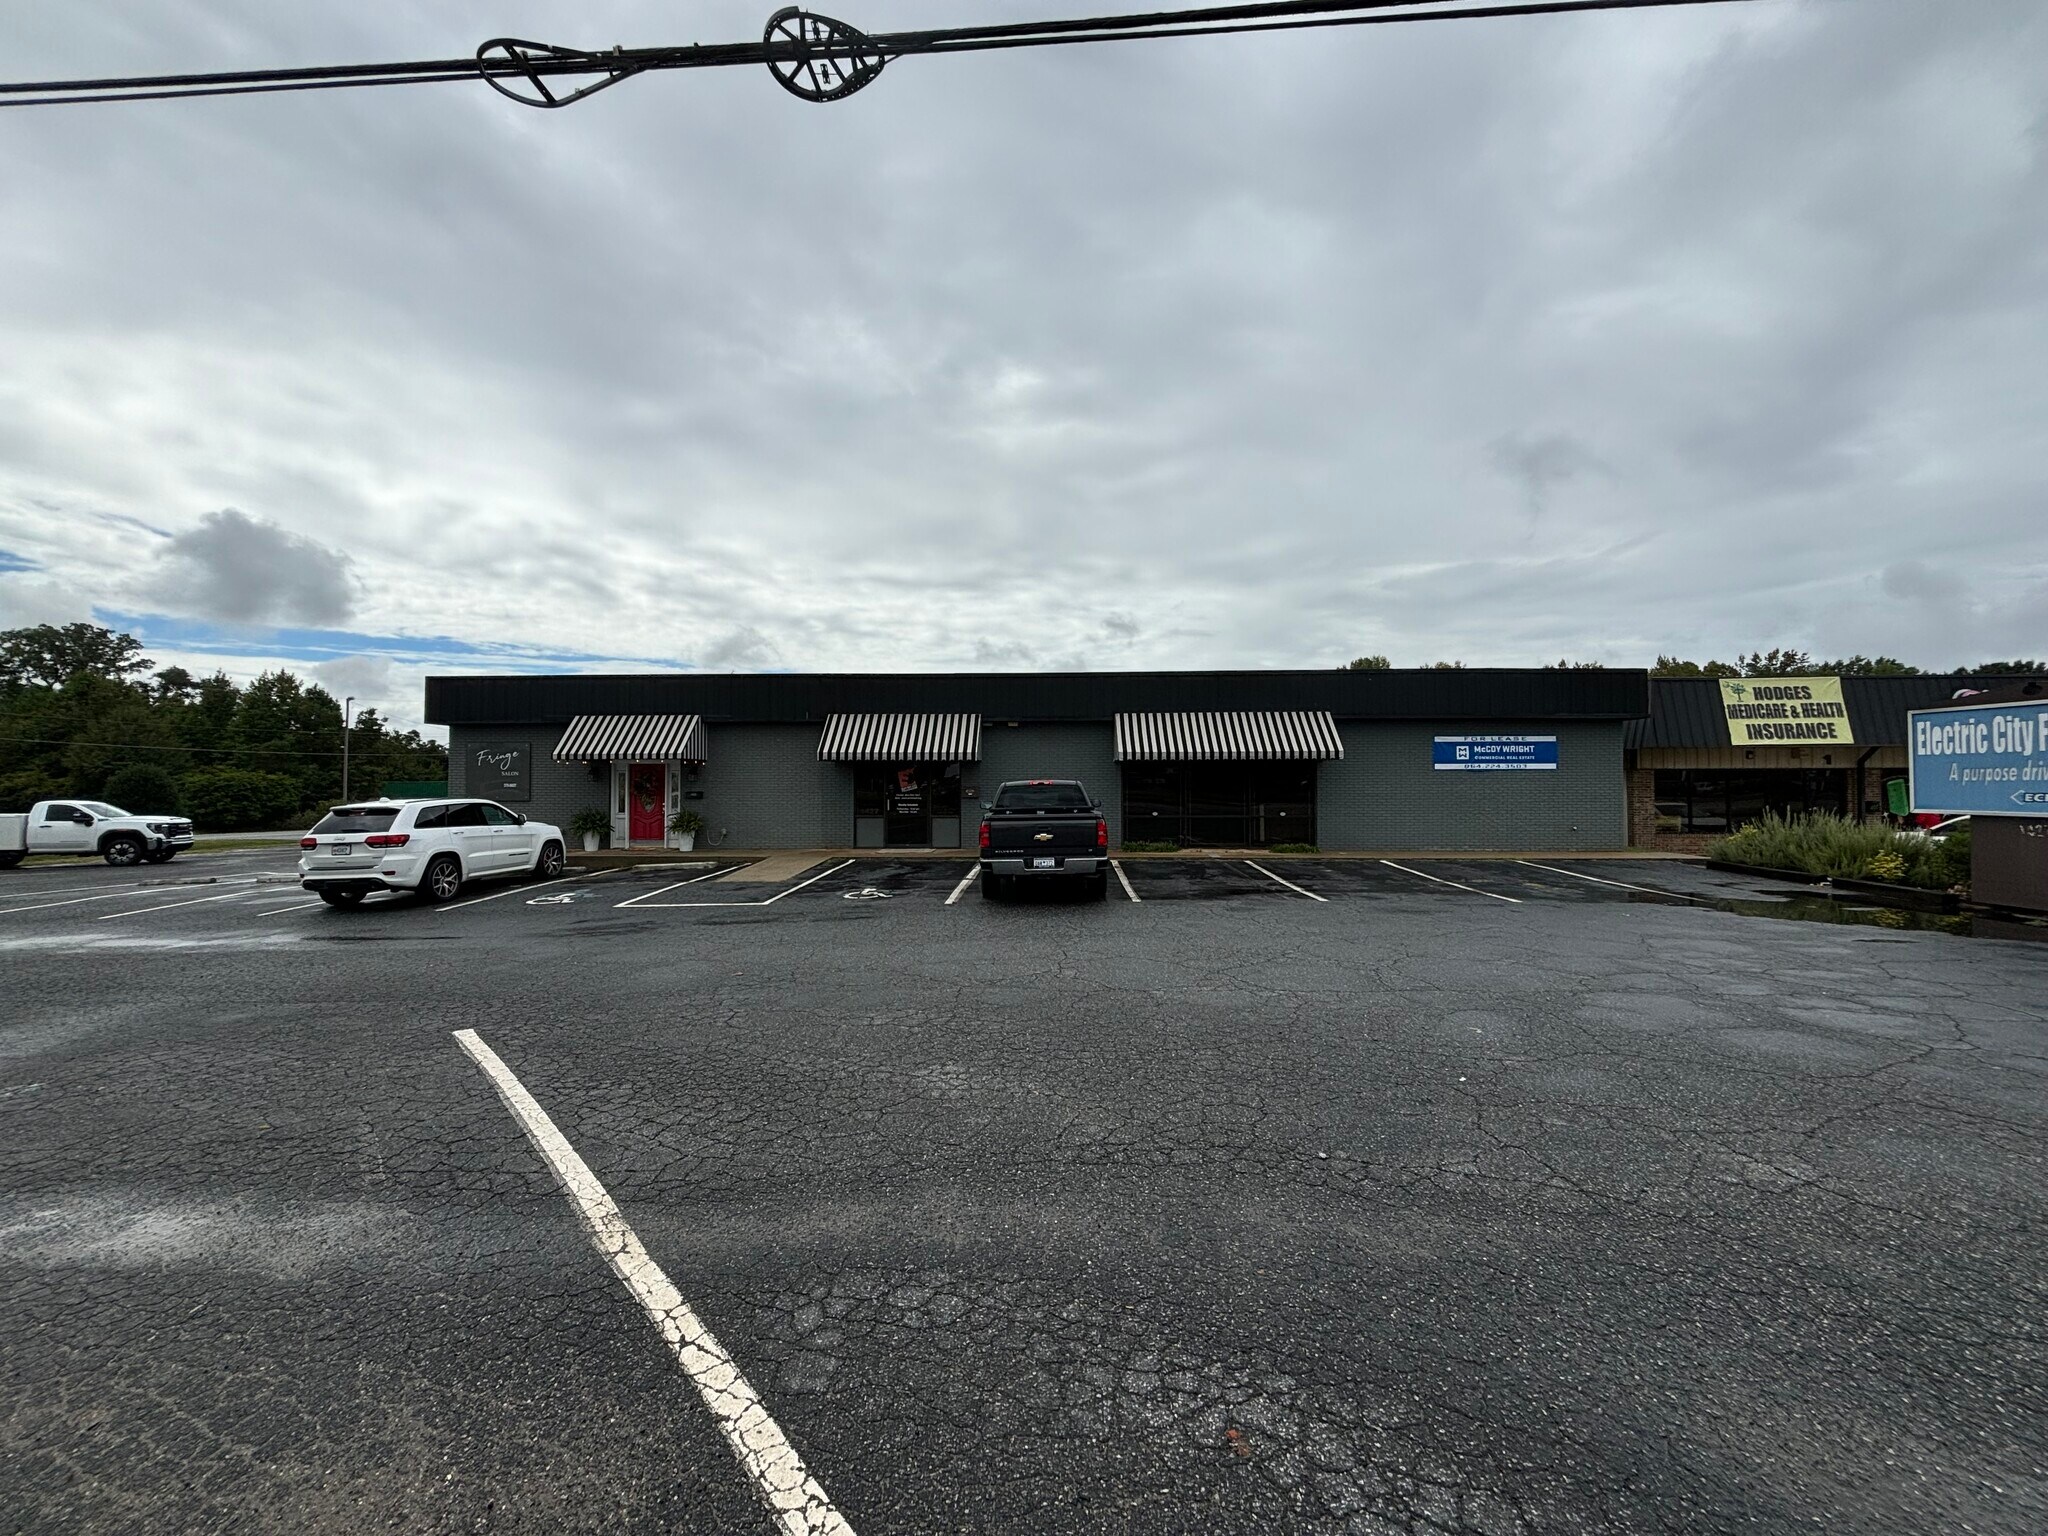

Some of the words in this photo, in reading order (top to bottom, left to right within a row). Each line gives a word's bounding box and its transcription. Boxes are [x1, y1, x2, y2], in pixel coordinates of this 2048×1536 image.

[1752, 686, 1813, 701] HODGES
[1726, 703, 1789, 719] MEDICARE
[1790, 705, 1800, 719] &
[1800, 702, 1845, 718] HEALTH
[1745, 722, 1838, 740] INSURANCE
[1916, 718, 1988, 756] Electric
[1992, 715, 2034, 756] City
[1474, 745, 1501, 753] McCOY
[1502, 745, 1535, 753] WRIGHT
[476, 749, 519, 770] Fringe
[1949, 763, 1958, 781] A
[1962, 767, 2018, 786] purpose
